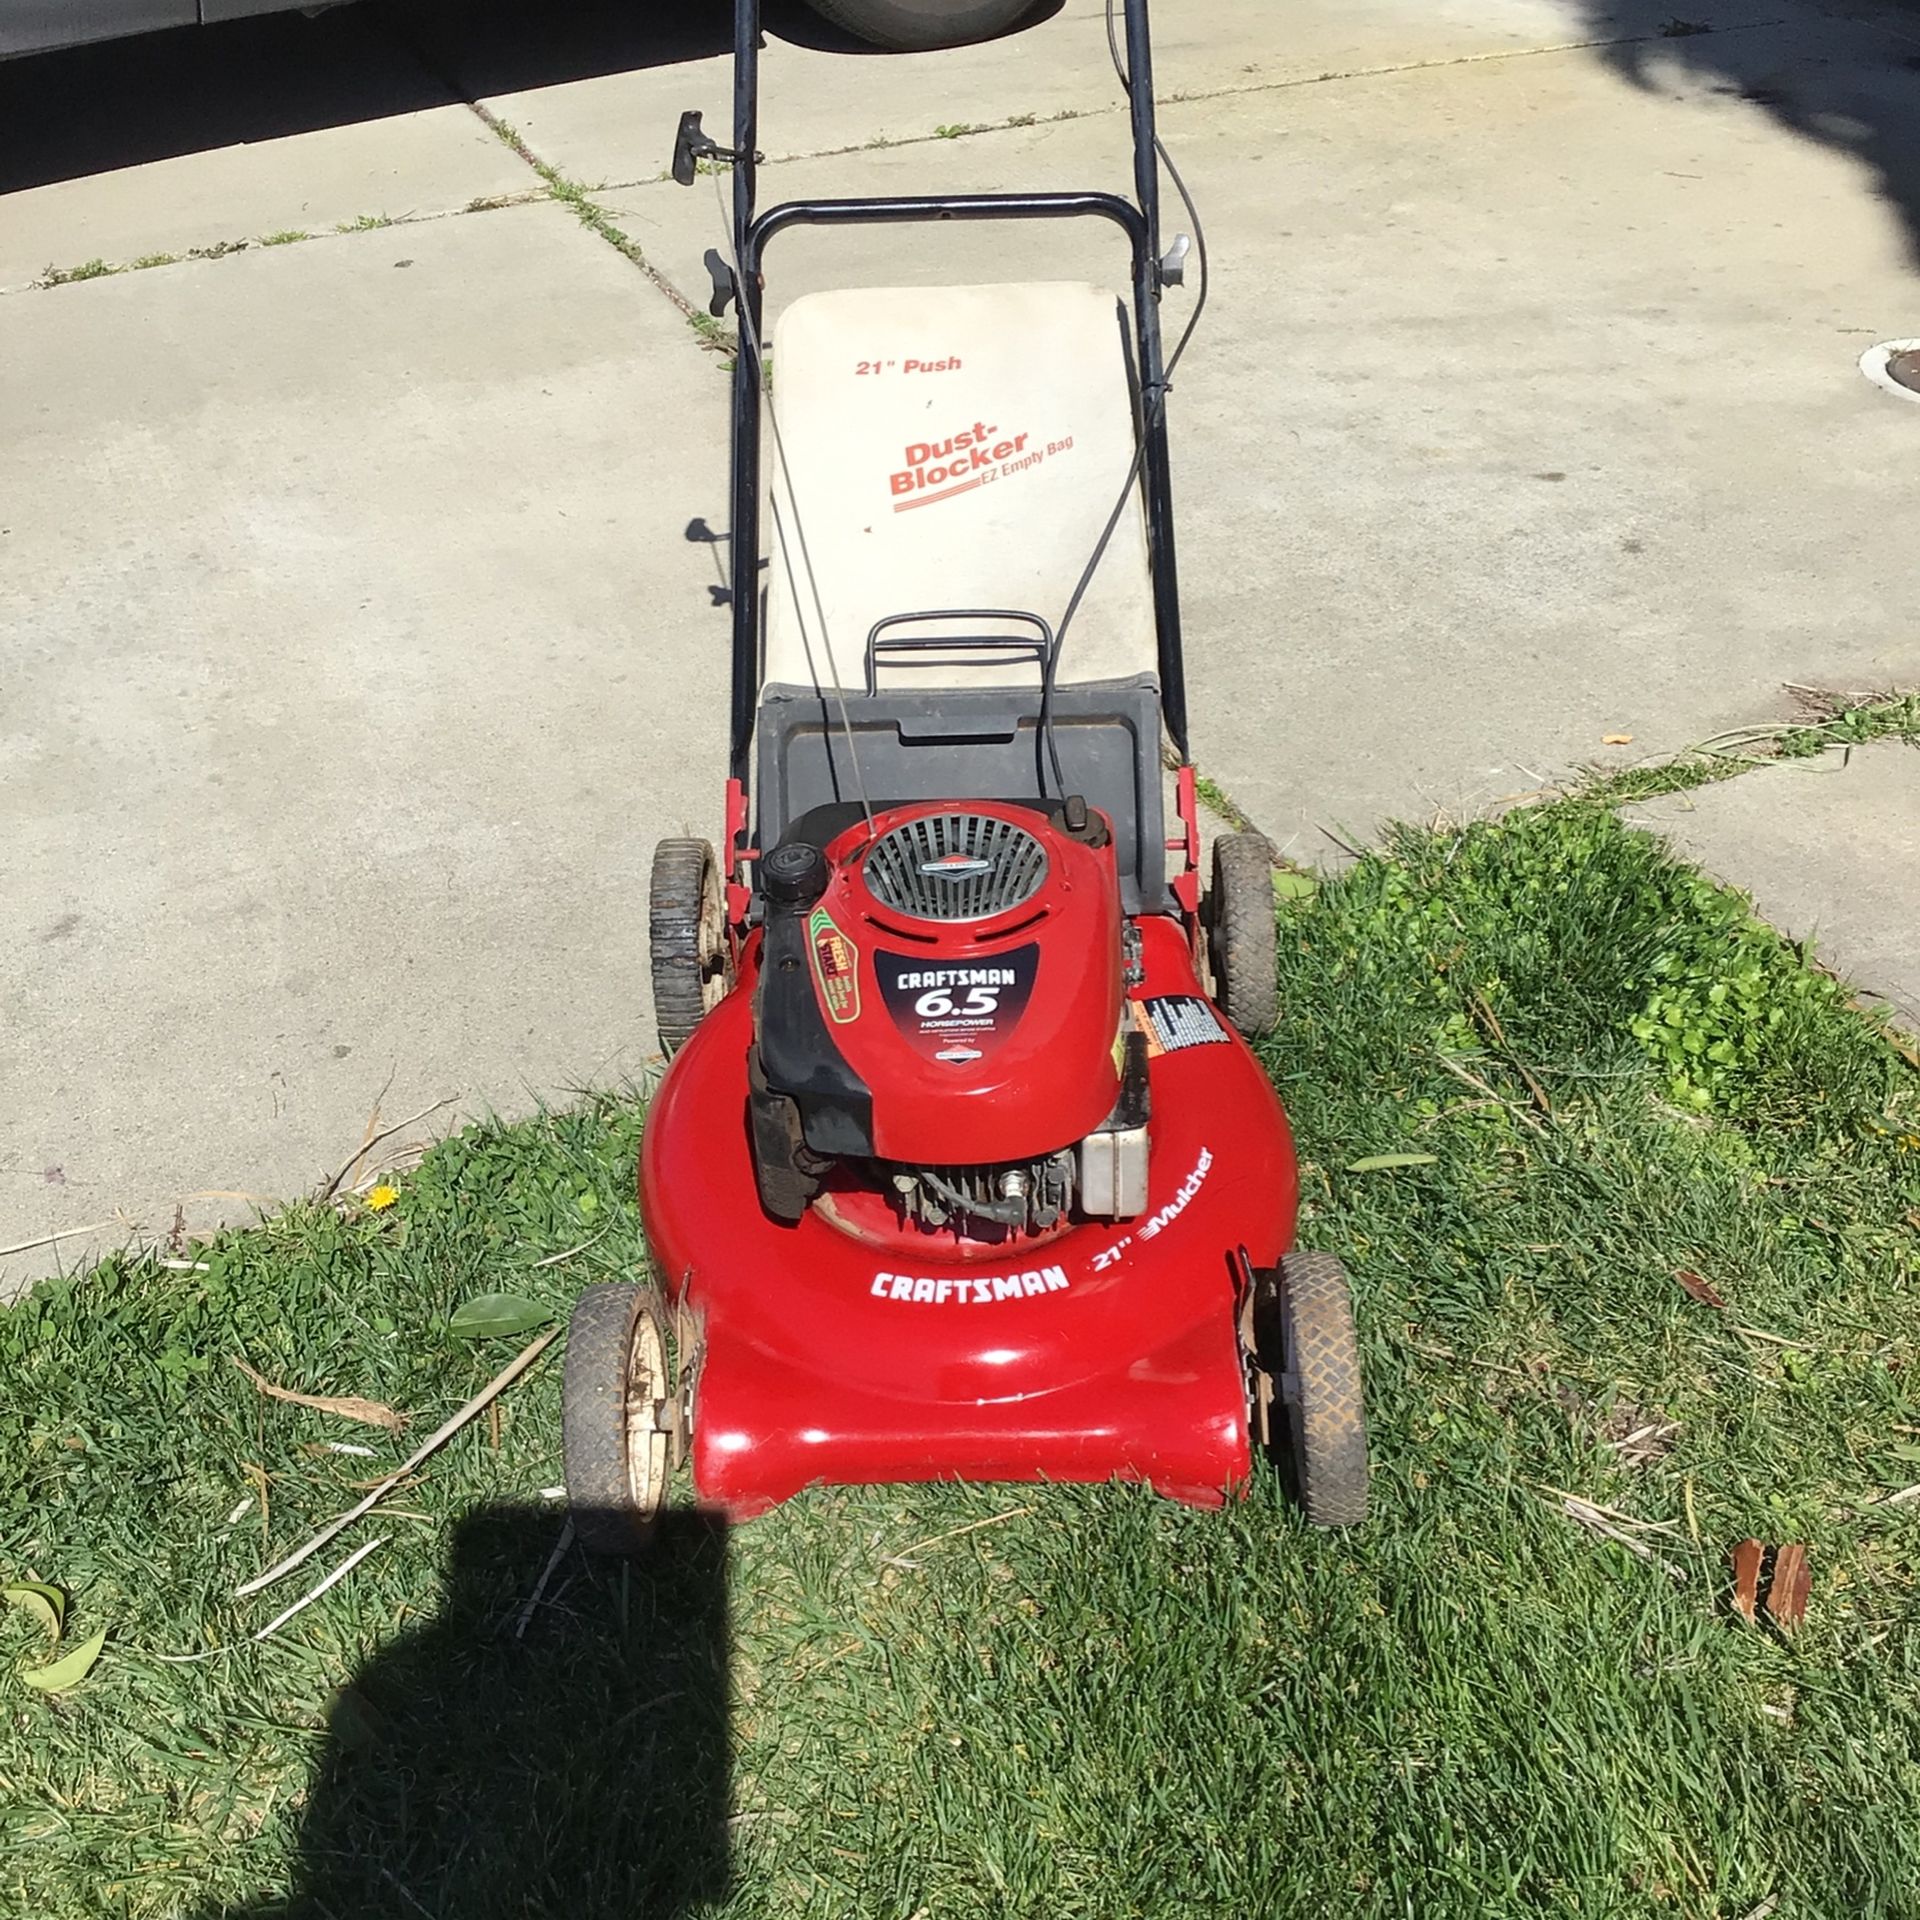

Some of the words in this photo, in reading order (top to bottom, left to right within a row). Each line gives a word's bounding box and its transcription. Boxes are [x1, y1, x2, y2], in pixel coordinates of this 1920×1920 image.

[855, 360, 895, 376] 21"
[903, 356, 962, 374] Push
[905, 421, 998, 467] Dust-
[980, 467, 999, 485] EZ
[1001, 450, 1044, 477] Empty
[1046, 435, 1074, 457] Bag
[889, 432, 1029, 496] Blocker
[829, 935, 849, 972] FRESH
[897, 968, 1016, 990] CRAFTSMAN
[914, 986, 1000, 1018] 6.5
[920, 1018, 994, 1028] HORSEPOWER
[1091, 1236, 1132, 1272] 21"
[1145, 1146, 1214, 1237] Mulcher
[870, 1265, 1070, 1304] CRAFTSMAN
